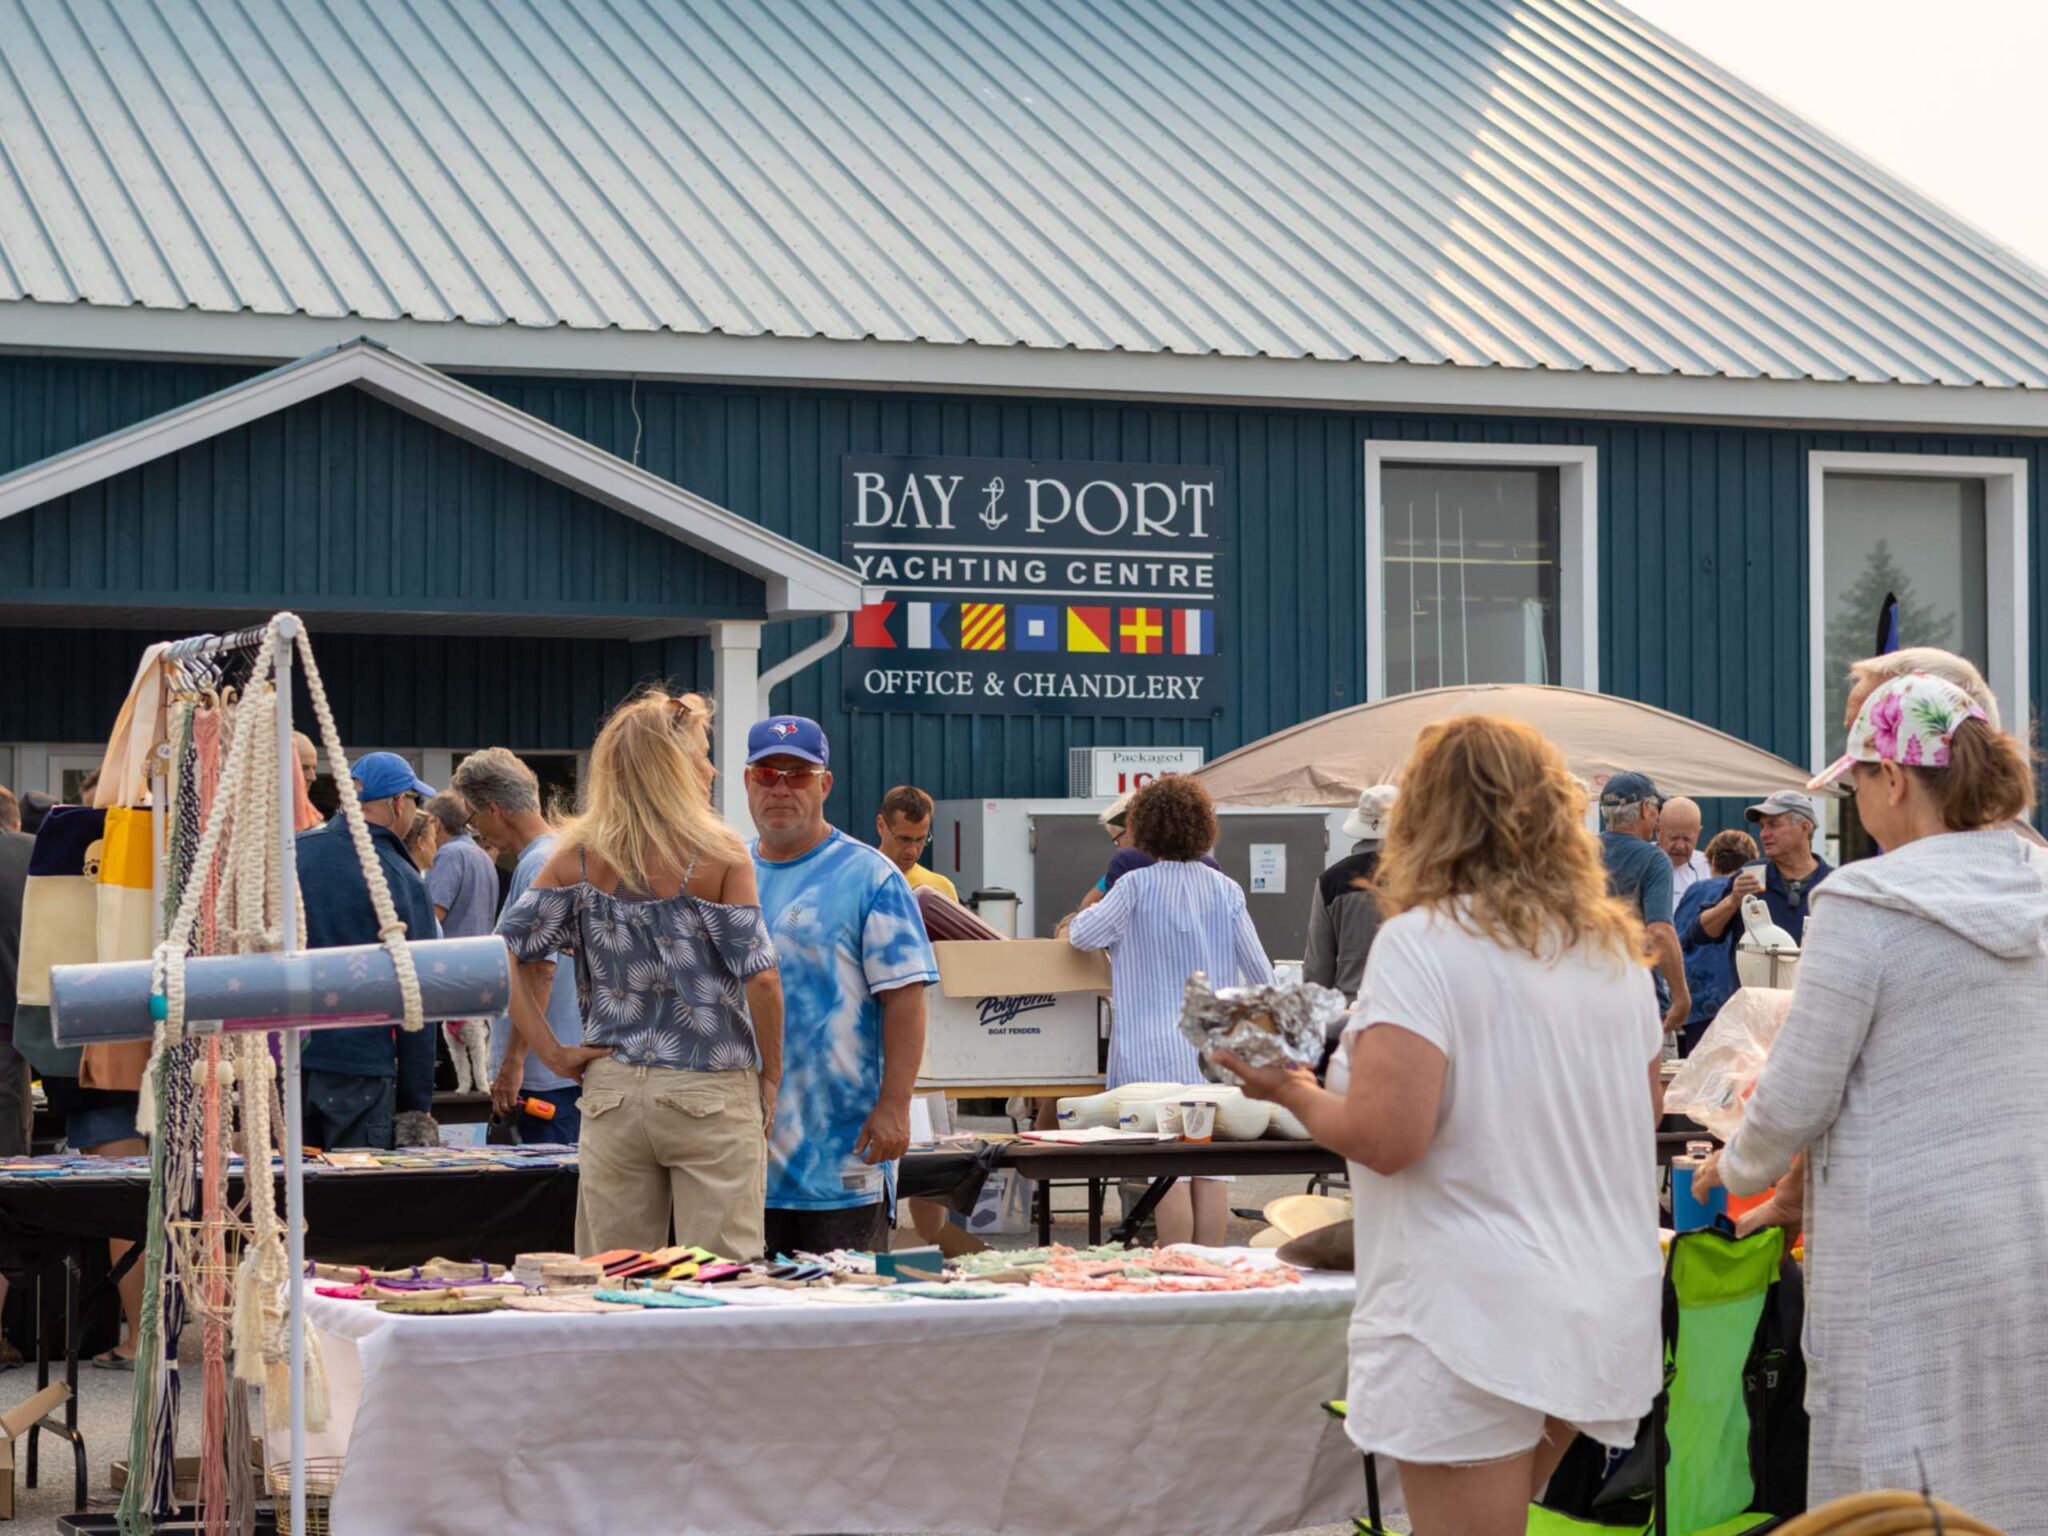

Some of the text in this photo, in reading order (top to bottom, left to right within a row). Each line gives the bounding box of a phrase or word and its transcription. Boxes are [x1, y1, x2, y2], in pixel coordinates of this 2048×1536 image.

[853, 472, 1214, 538] BAY PORT
[853, 555, 1214, 588] YACHTING CENTRE
[864, 669, 1205, 700] OFFICE & CHANDLERY
[1113, 752, 1183, 764] Packaged
